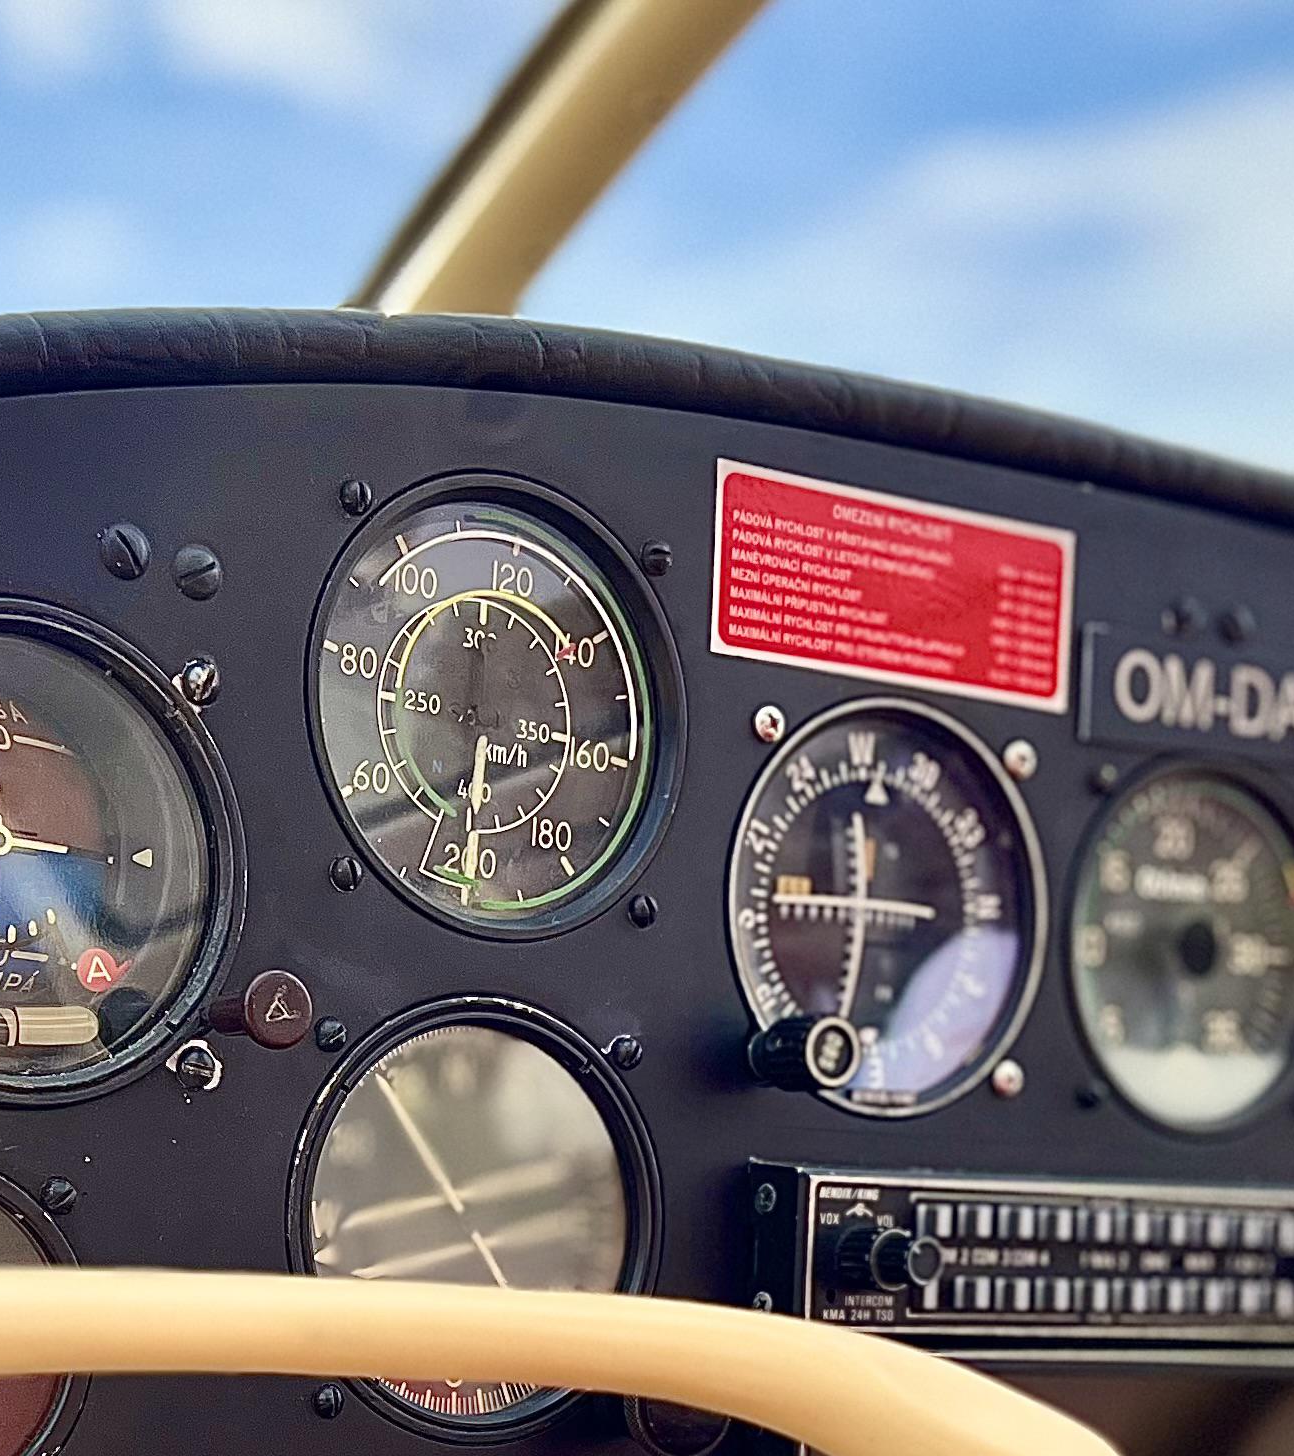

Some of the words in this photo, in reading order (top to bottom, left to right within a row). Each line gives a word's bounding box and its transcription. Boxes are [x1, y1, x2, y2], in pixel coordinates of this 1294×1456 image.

[732, 509, 774, 528] PÁDOVÁ
[774, 518, 825, 539] RYCHLOST
[732, 527, 773, 546] PÁDOVÁ
[773, 537, 824, 558] RYCHLOST
[393, 563, 439, 598] 100
[491, 560, 534, 596] 120
[802, 561, 853, 582] RYCHLOST
[729, 585, 783, 606] MAXIMÁLNÍ
[728, 623, 782, 644] MAXIMÁLNÍ
[729, 604, 783, 625] MAXIMÁLNÍ
[783, 614, 834, 634] RYCHLOST
[339, 646, 378, 680] 80
[404, 692, 441, 716] 250
[516, 719, 551, 744] 350
[569, 736, 610, 772] 160
[848, 731, 876, 766] W
[352, 760, 391, 794] 60
[531, 816, 573, 852] 180
[86, 954, 112, 984] A
[819, 1212, 840, 1225] VOX
[876, 1215, 894, 1228] VOL
[822, 1308, 846, 1321] KMA
[844, 1295, 894, 1307] INTERCOM
